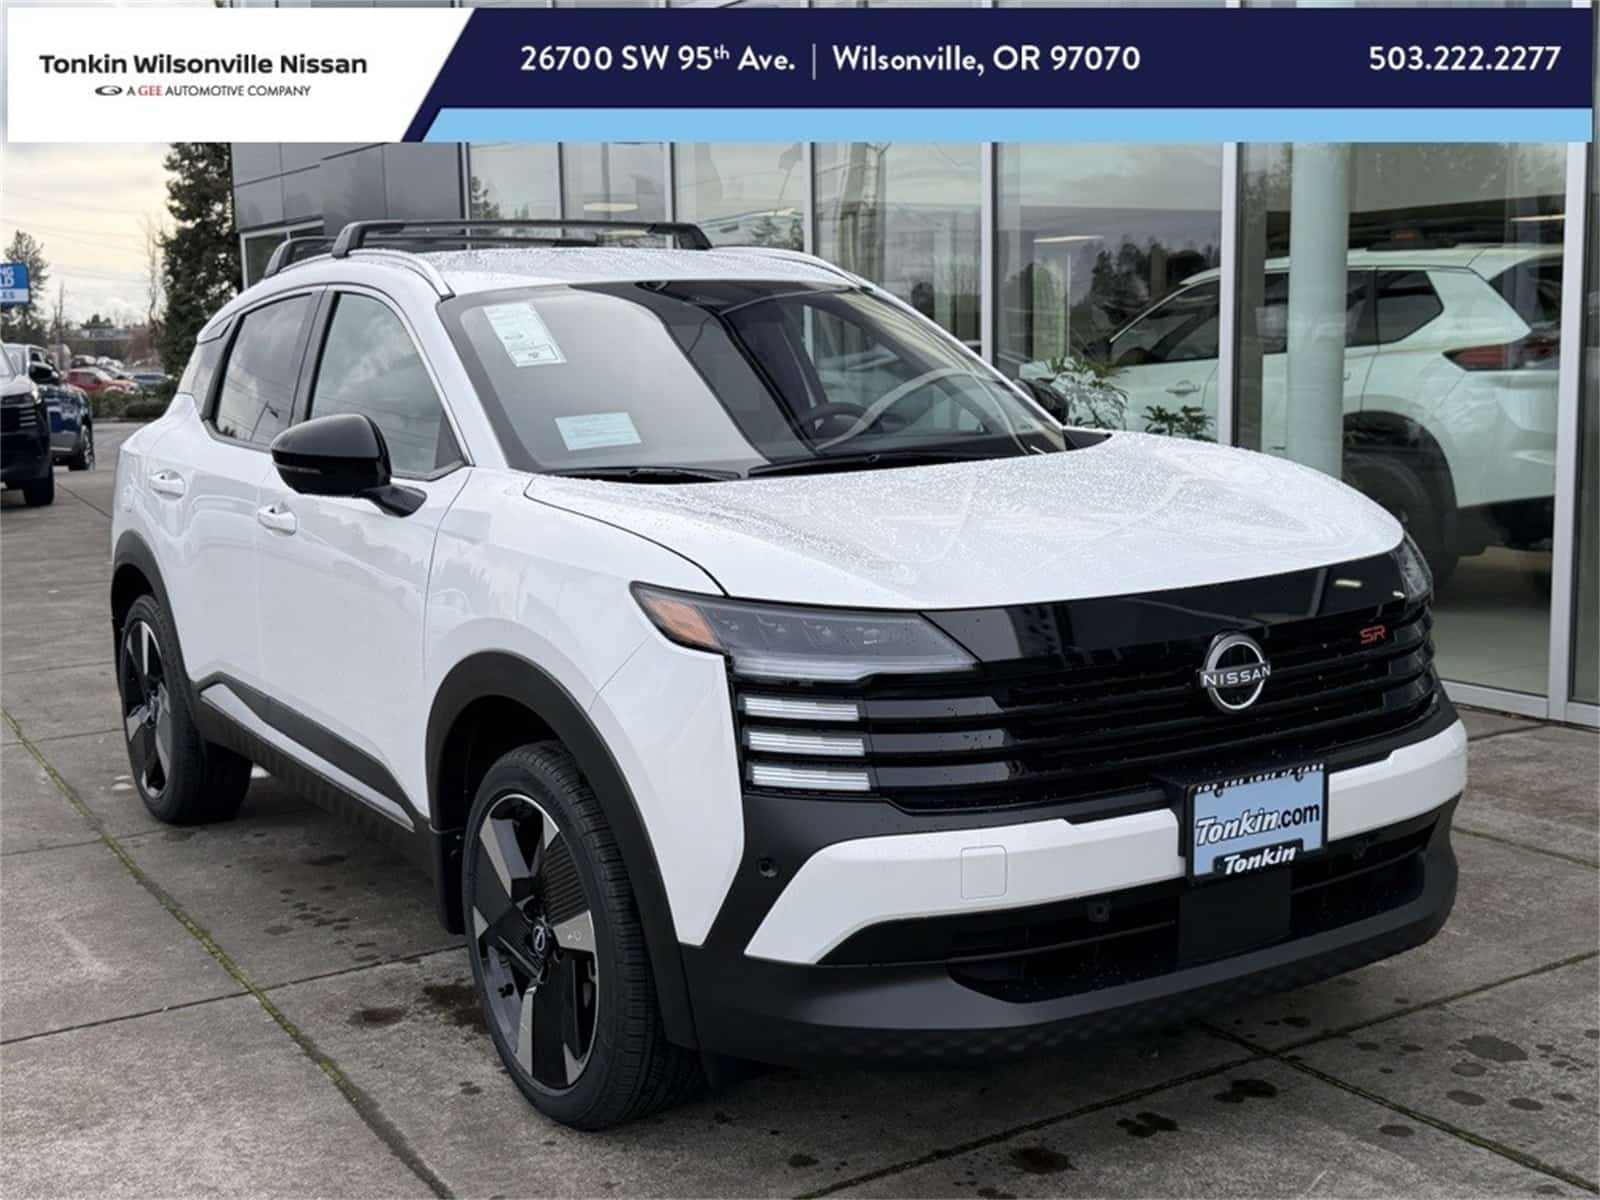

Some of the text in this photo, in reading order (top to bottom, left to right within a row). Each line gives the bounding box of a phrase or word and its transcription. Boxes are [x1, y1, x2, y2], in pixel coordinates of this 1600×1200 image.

[1359, 625, 1387, 645] SR
[1203, 663, 1272, 686] NISSAN
[1196, 803, 1320, 847] Tonkin.com
[1223, 845, 1297, 875] Tonkin
